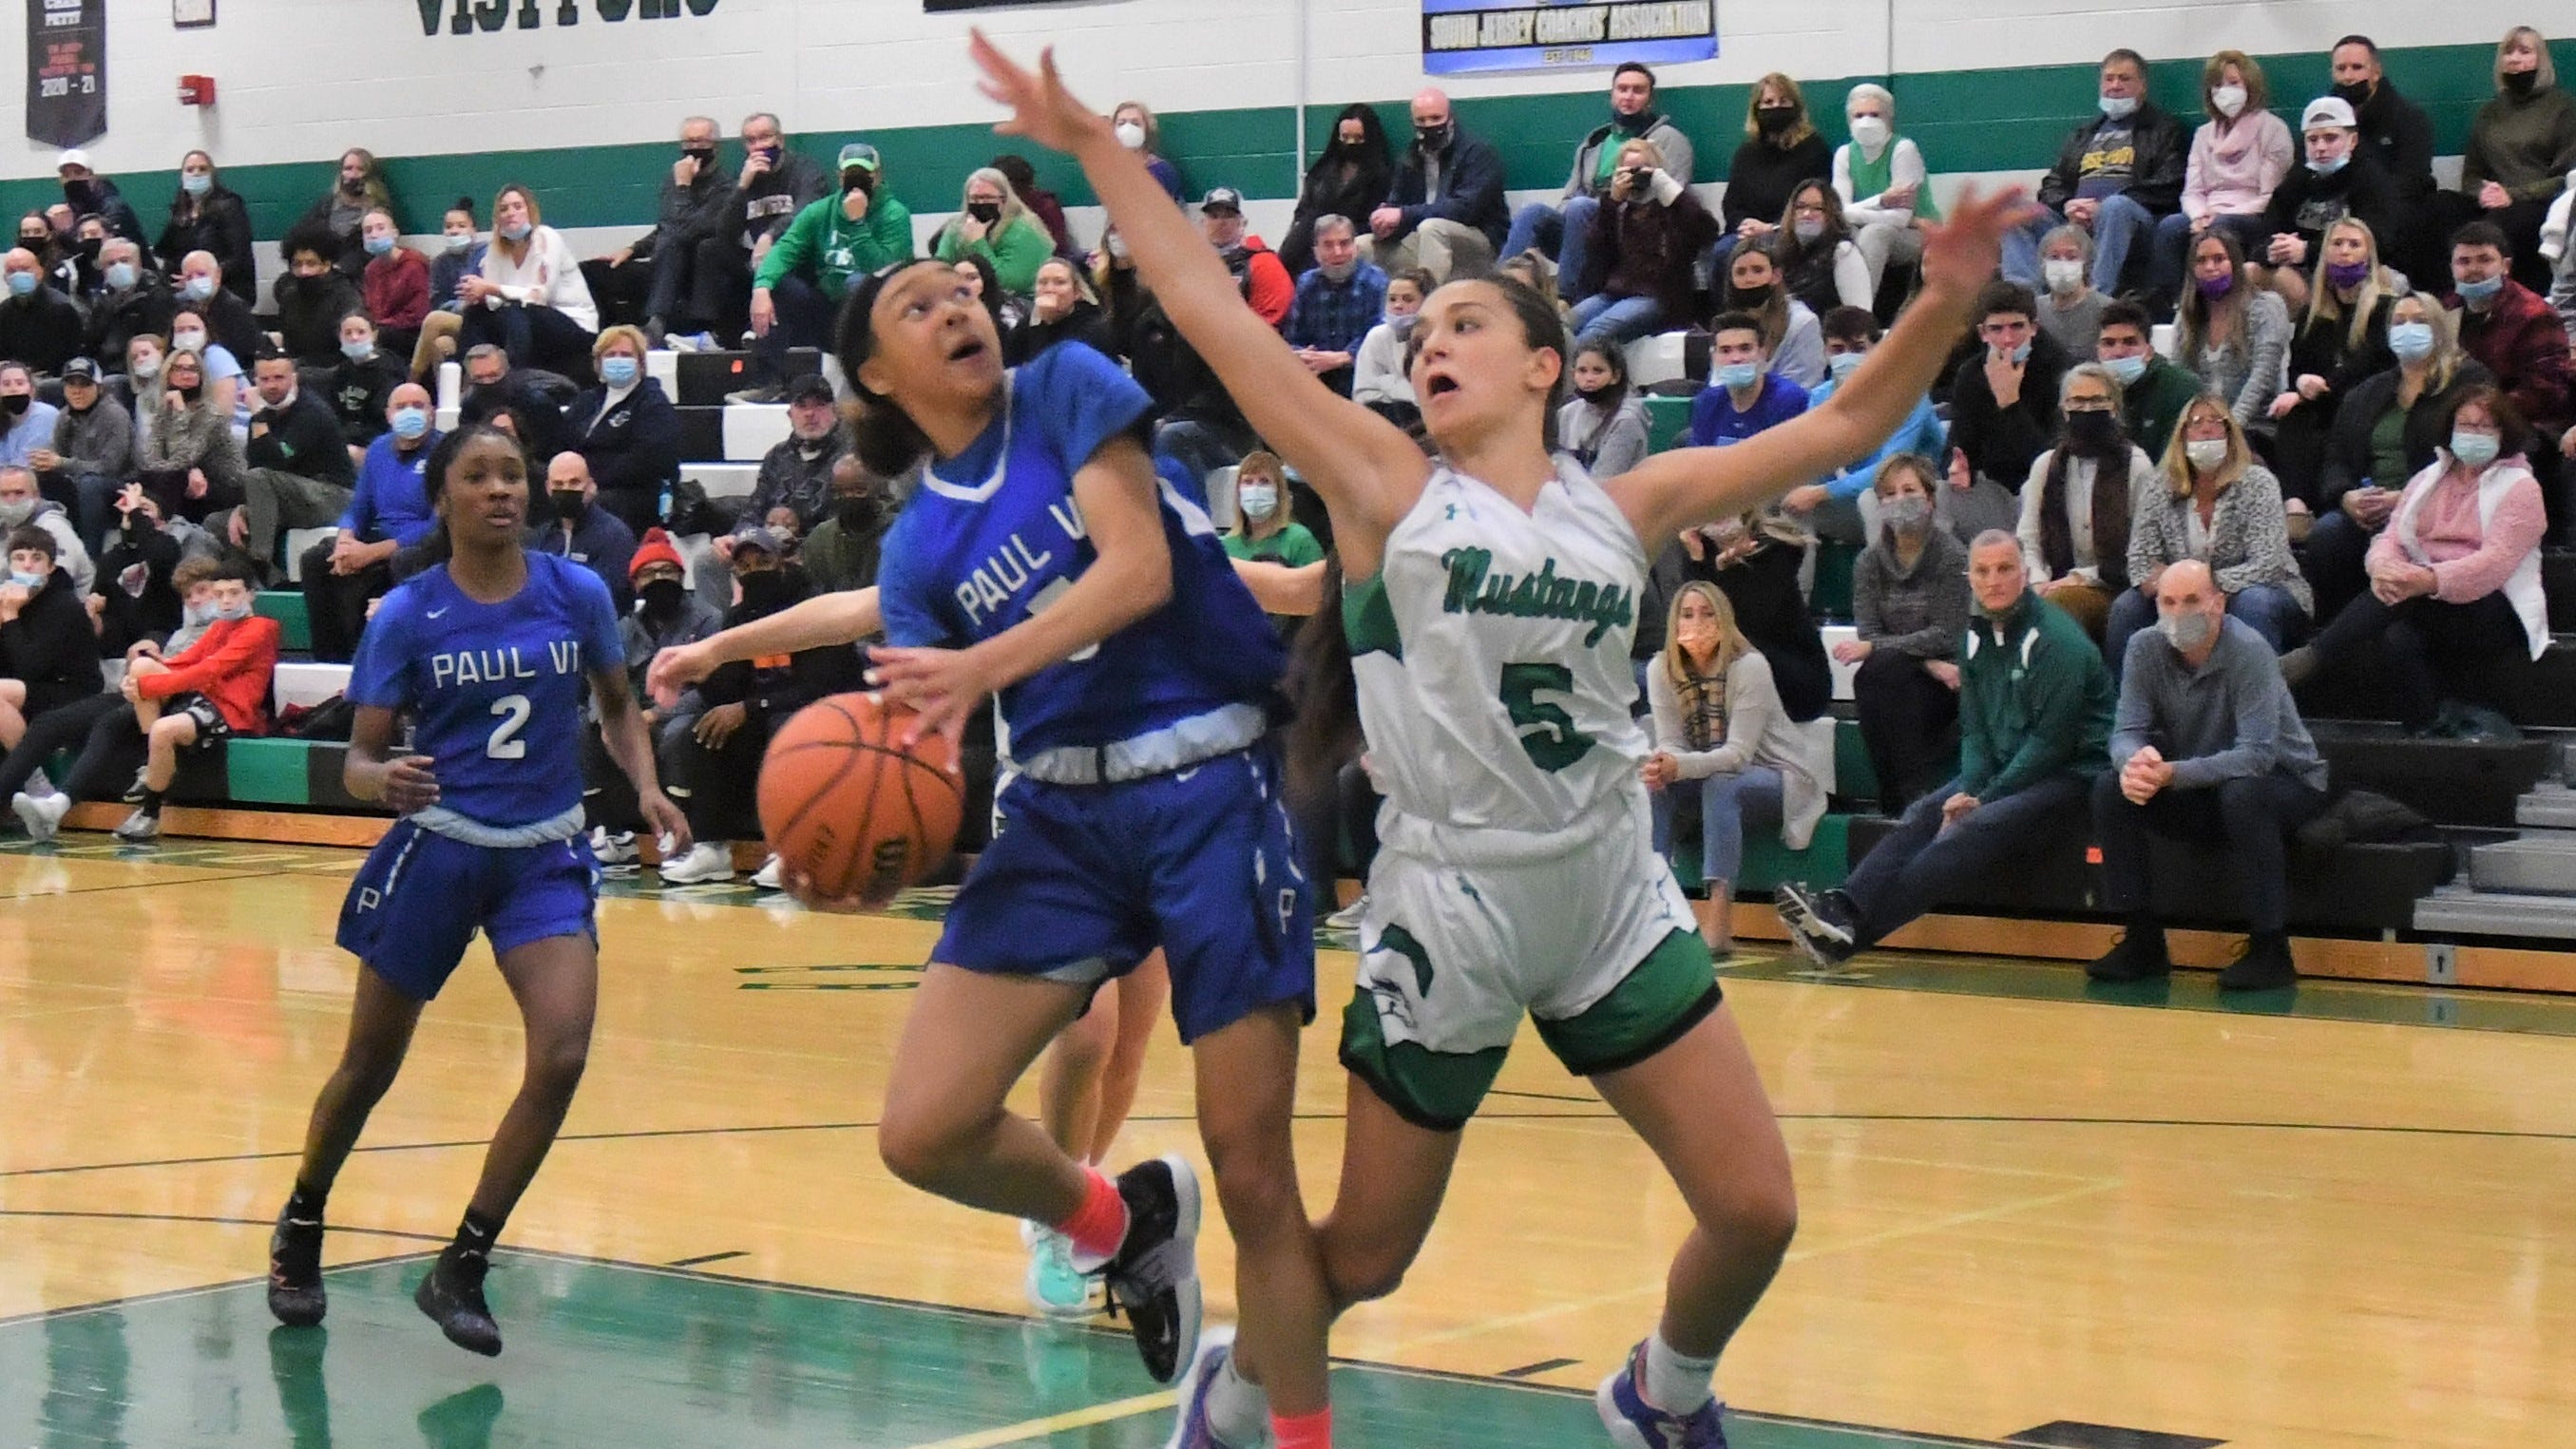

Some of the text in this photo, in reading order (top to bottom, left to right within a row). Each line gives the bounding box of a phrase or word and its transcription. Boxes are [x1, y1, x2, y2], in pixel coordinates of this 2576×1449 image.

[416, 0, 715, 36] VISI
[1429, 13, 1479, 49] SOUTH
[1479, 10, 1535, 47] JERSEY
[1609, 2, 1710, 40] ASSOCIATION
[956, 533, 1052, 626] PAUL
[1441, 545, 1633, 649] Mustangs
[431, 640, 579, 689] PAUL VI
[487, 694, 532, 759] 2
[1498, 662, 1597, 774] 5
[356, 887, 381, 914] P
[1278, 888, 1296, 934] P
